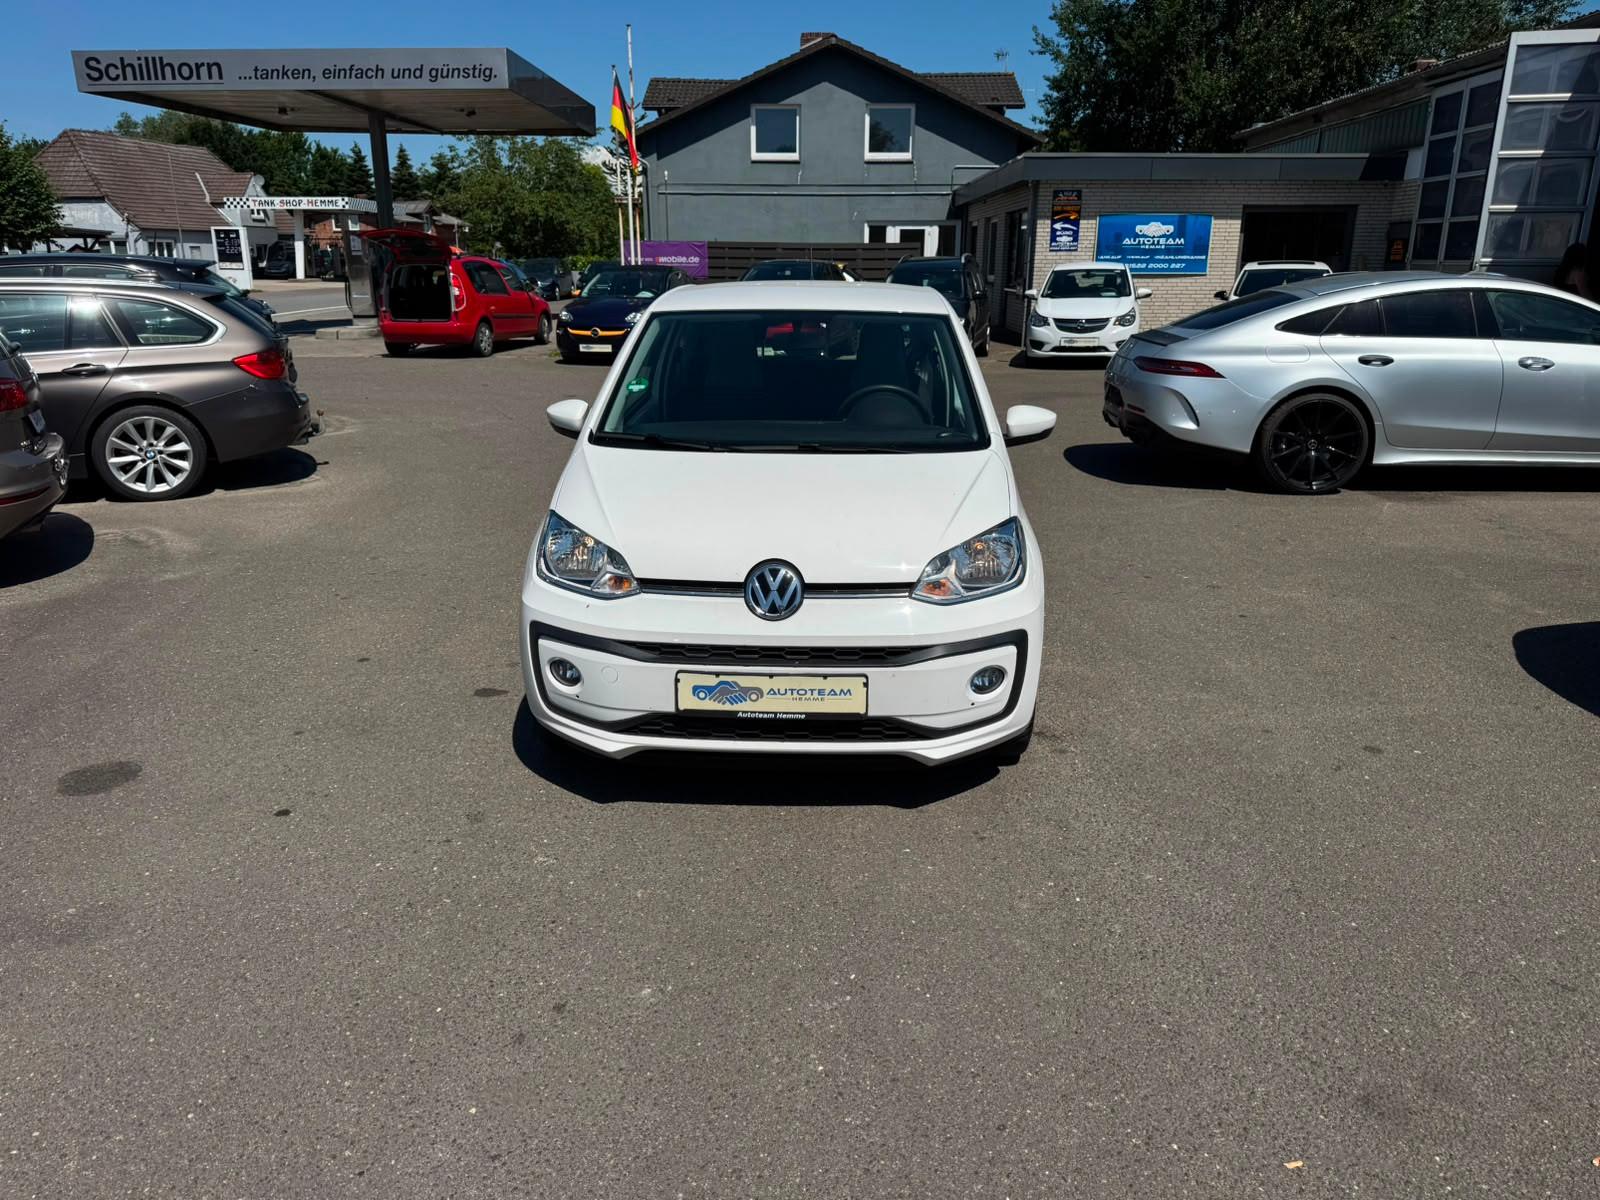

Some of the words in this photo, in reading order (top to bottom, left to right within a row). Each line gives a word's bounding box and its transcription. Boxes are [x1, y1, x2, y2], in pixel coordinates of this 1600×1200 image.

[85, 56, 224, 82] Schillhorn
[322, 64, 385, 80] einfach
[391, 64, 424, 80] und
[428, 64, 498, 82] günstig.
[766, 687, 852, 697] AUTOTEAM
[737, 711, 775, 719] Autoteam
